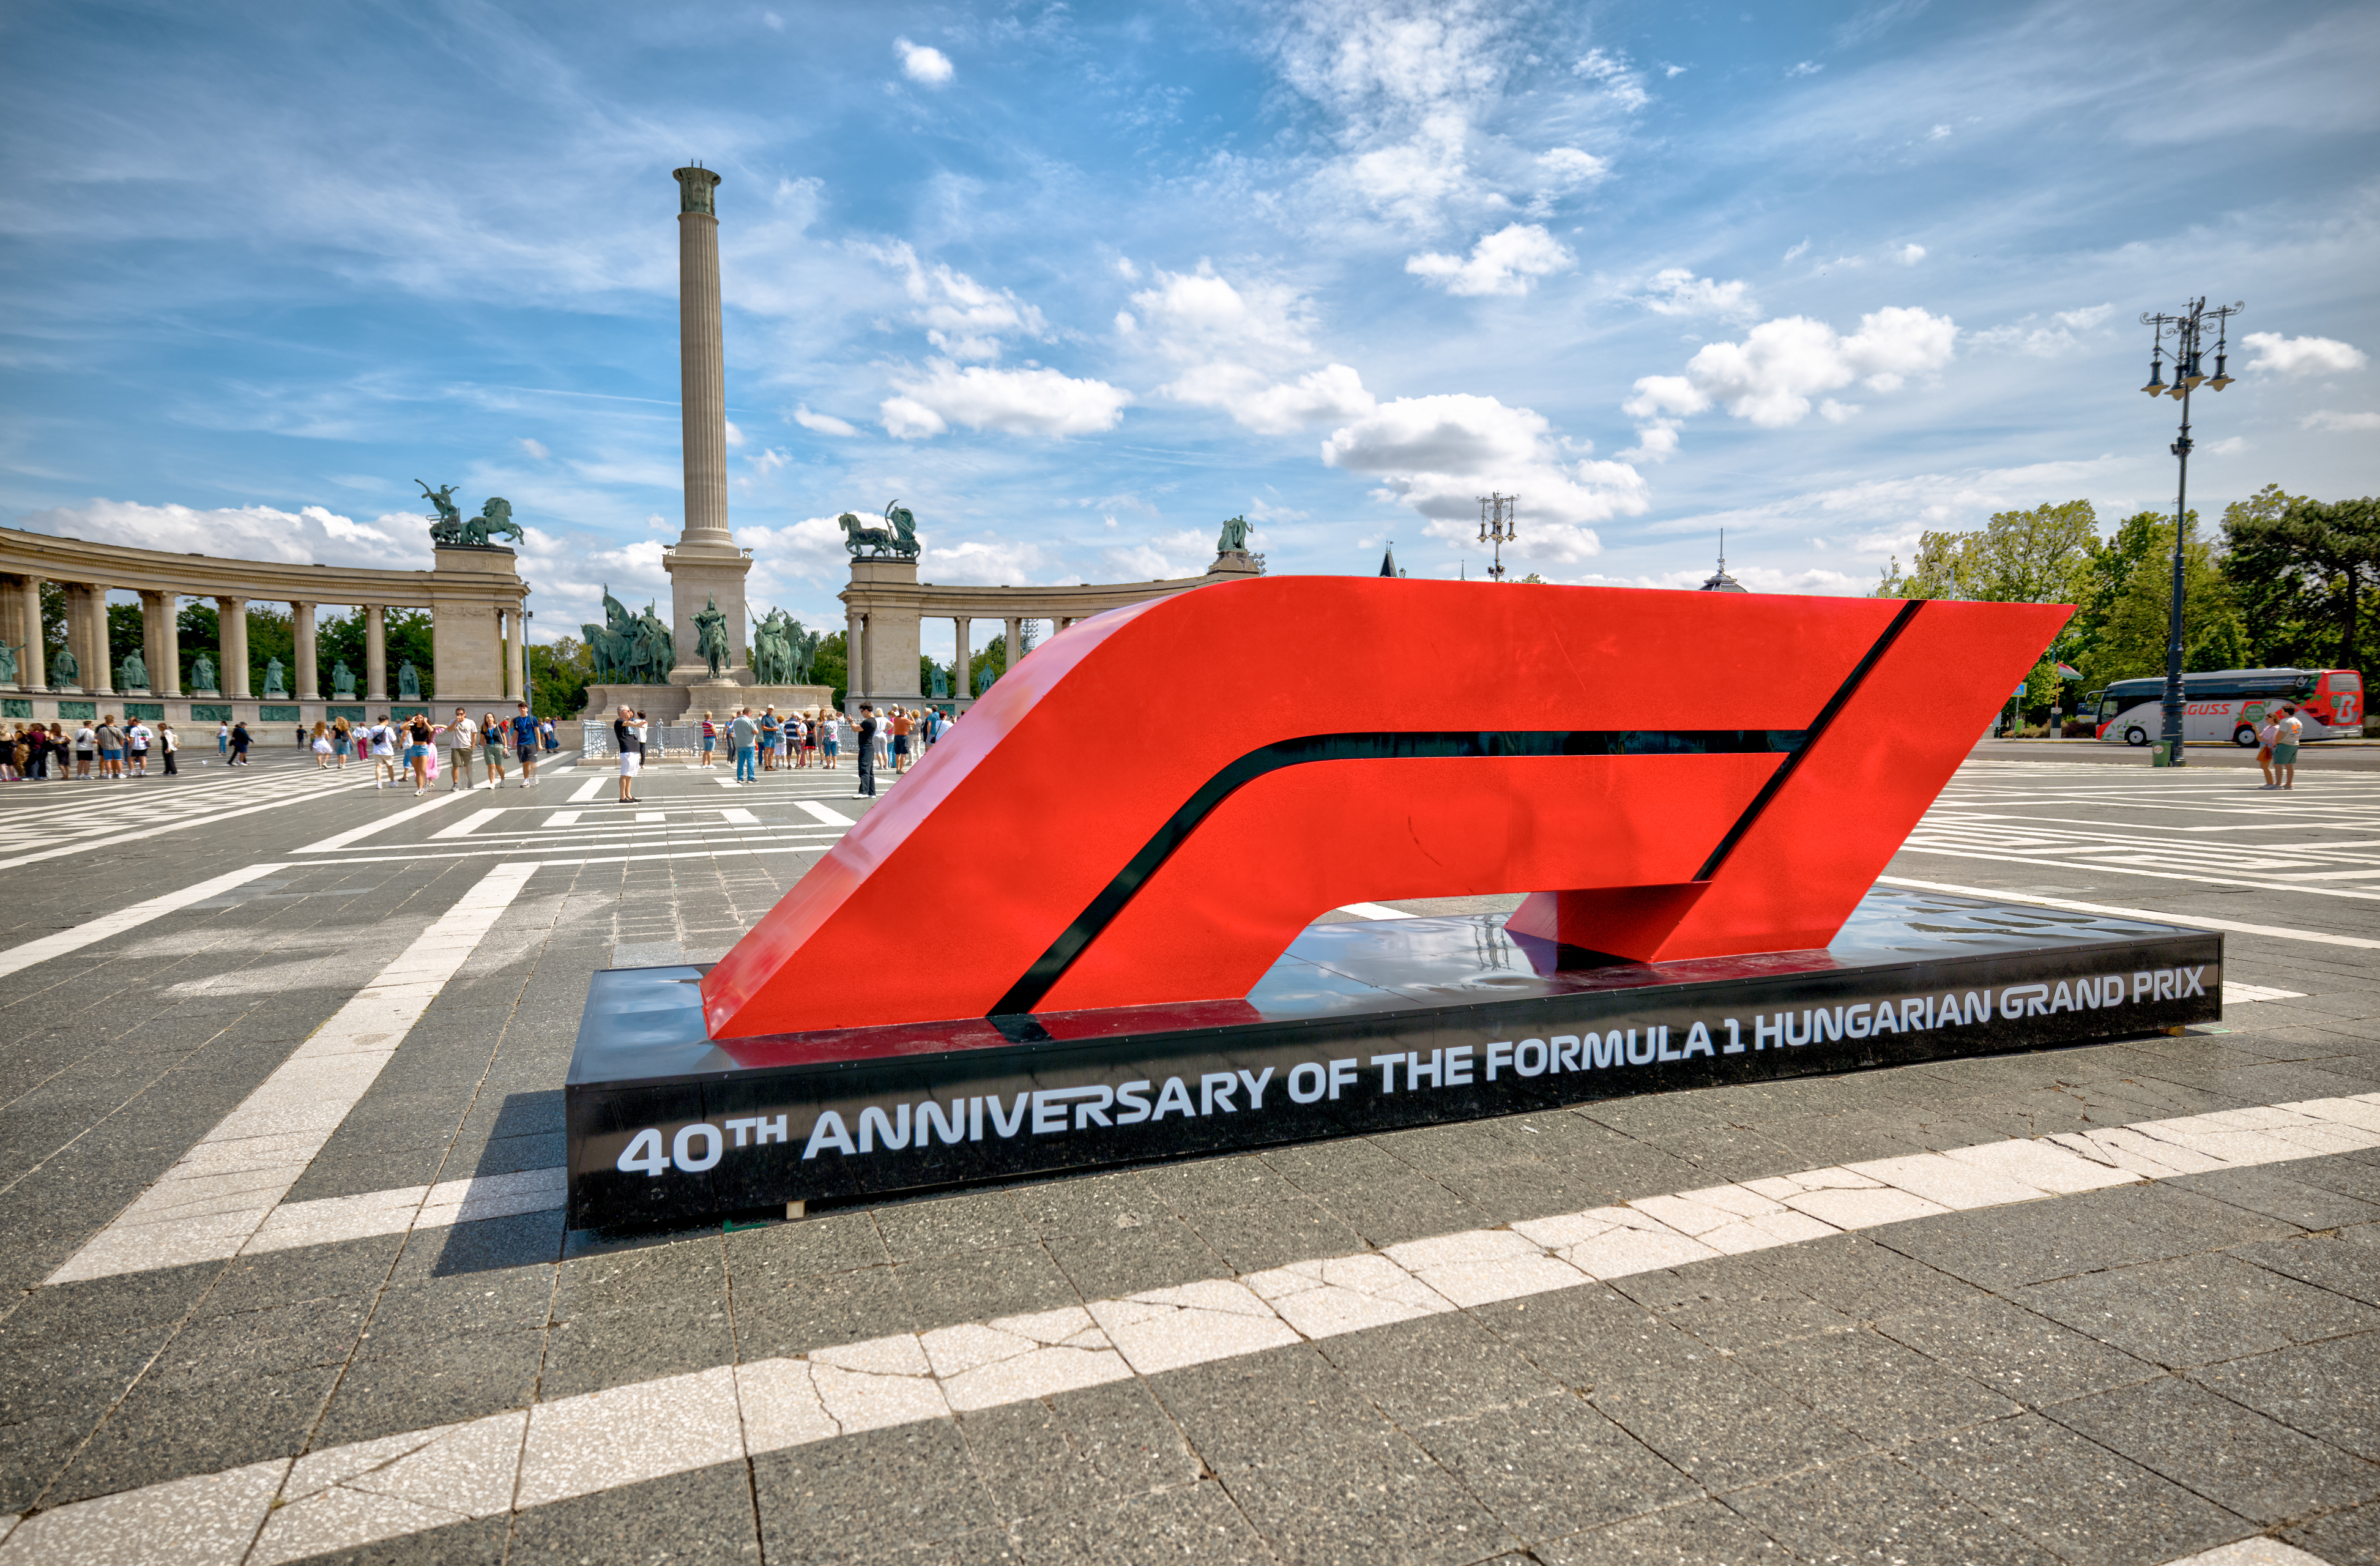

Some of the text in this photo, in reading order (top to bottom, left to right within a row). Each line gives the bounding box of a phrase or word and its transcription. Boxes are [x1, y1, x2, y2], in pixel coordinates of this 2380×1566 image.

[616, 965, 2205, 1177] 40TH ANNIVERSARY OF THE FORMULA 1 HUNGARIAN GRAND PRIX
